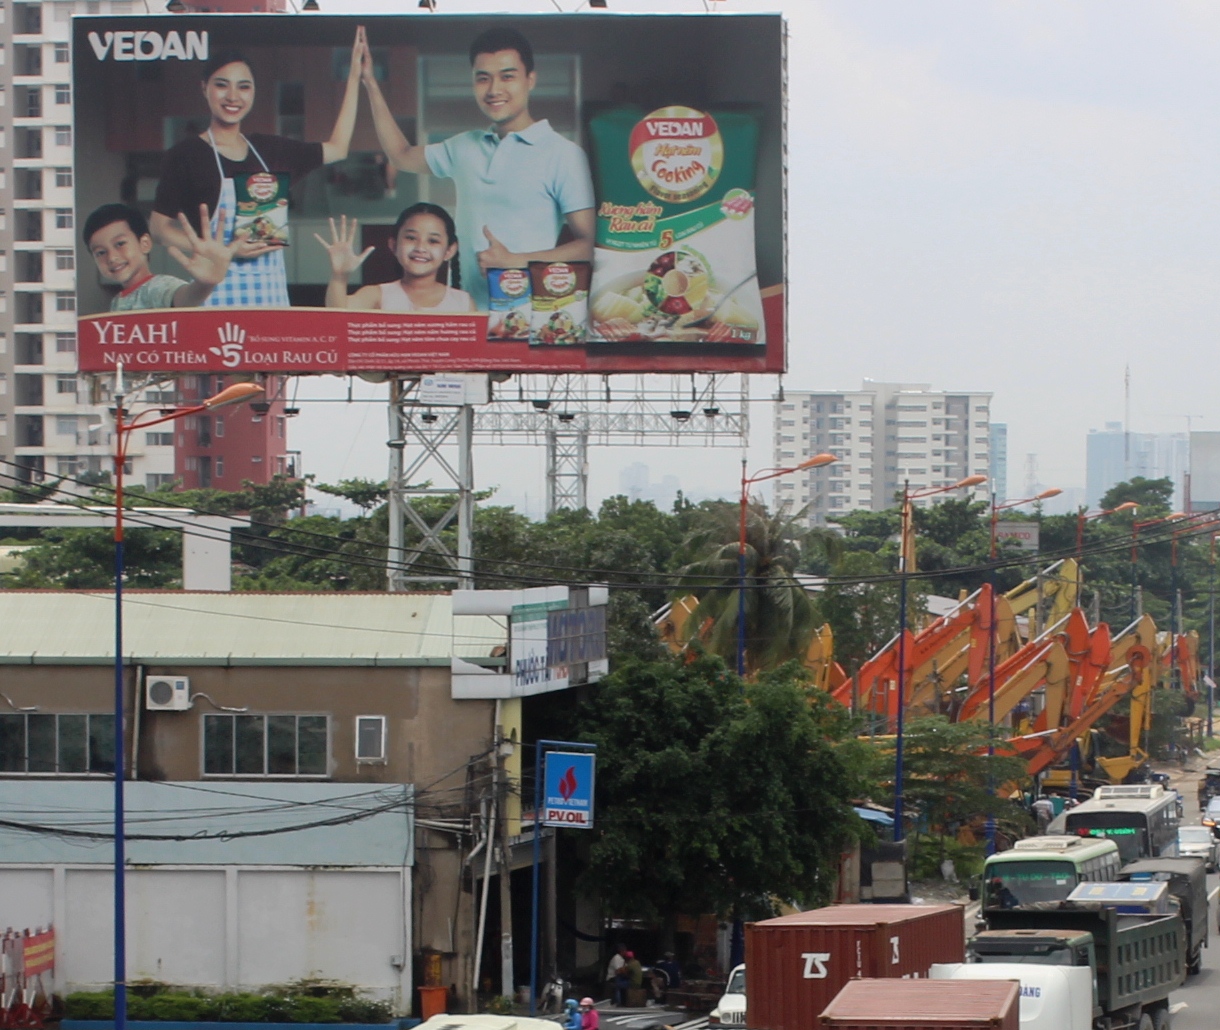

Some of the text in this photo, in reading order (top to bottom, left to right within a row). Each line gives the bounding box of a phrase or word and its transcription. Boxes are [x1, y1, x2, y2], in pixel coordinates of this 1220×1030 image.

[87, 30, 209, 61] VEDAN
[646, 121, 704, 136] VEDAN
[651, 159, 706, 184] Cooking
[660, 229, 674, 249] 5
[91, 320, 178, 345] YEAH!
[730, 329, 751, 341] 1 kg
[103, 351, 133, 365] NAY
[136, 349, 160, 365] CÓ
[166, 349, 208, 365] THÊM
[282, 350, 313, 364] RAU
[548, 810, 586, 824] PV OIL
[801, 952, 831, 979] TS
